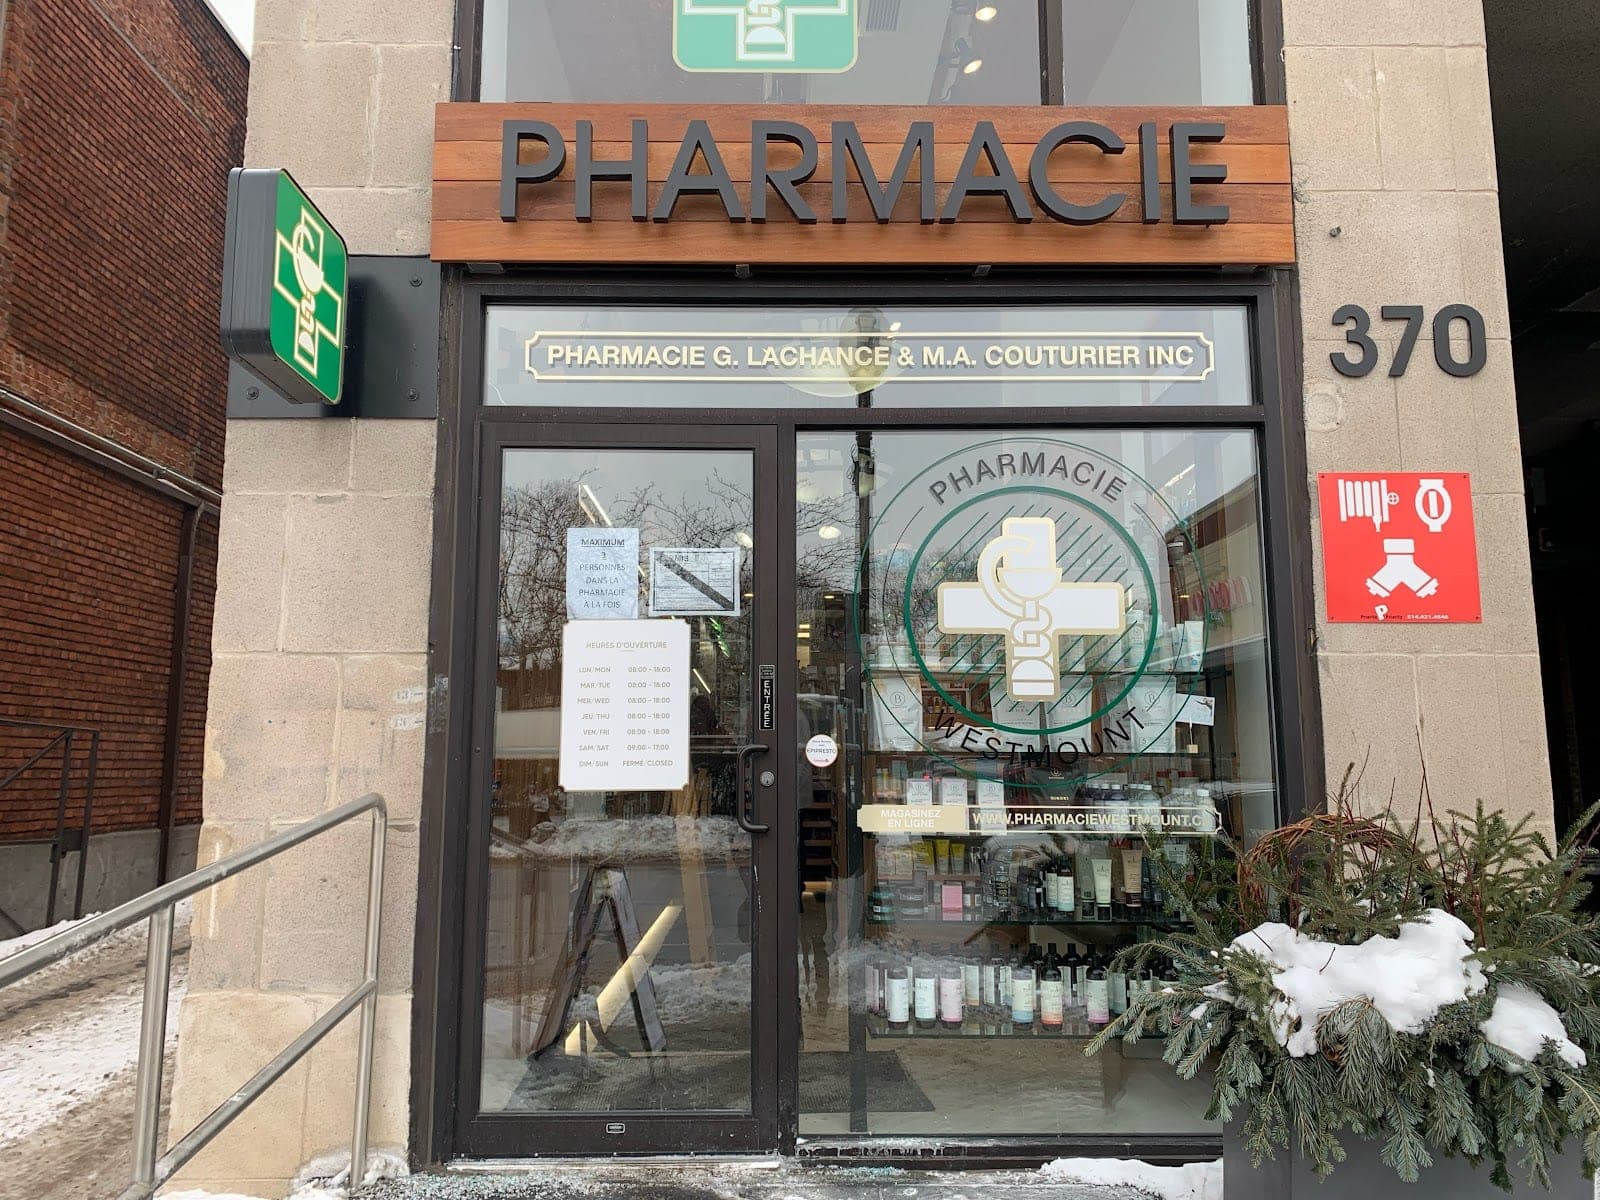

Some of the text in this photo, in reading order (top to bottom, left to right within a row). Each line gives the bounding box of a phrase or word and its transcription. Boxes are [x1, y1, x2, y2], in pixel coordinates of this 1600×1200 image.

[500, 120, 1230, 225] PHARMACIE
[1329, 304, 1487, 378] 370
[547, 345, 1195, 367] PHARMACIE G. LACHANCE & M.A. COUTURIER INC
[929, 451, 1128, 504] PHARMACIE
[581, 538, 625, 547] MAXIMUM
[579, 563, 626, 571] PERSONNES
[585, 576, 619, 584] DANS LA
[578, 588, 626, 597] PHARMACIE
[592, 601, 601, 609] LA
[603, 601, 621, 609] FOIS
[586, 641, 668, 649] HEURES D'OUVERTURE
[763, 680, 771, 728] ENTREE
[933, 706, 1145, 768] WESTMOUNT
[881, 809, 942, 818] MAGASINEZ
[887, 819, 935, 828] EN LIGNE
[972, 812, 1212, 827] WWW.PHARMACIEWESTMOUNT.C
